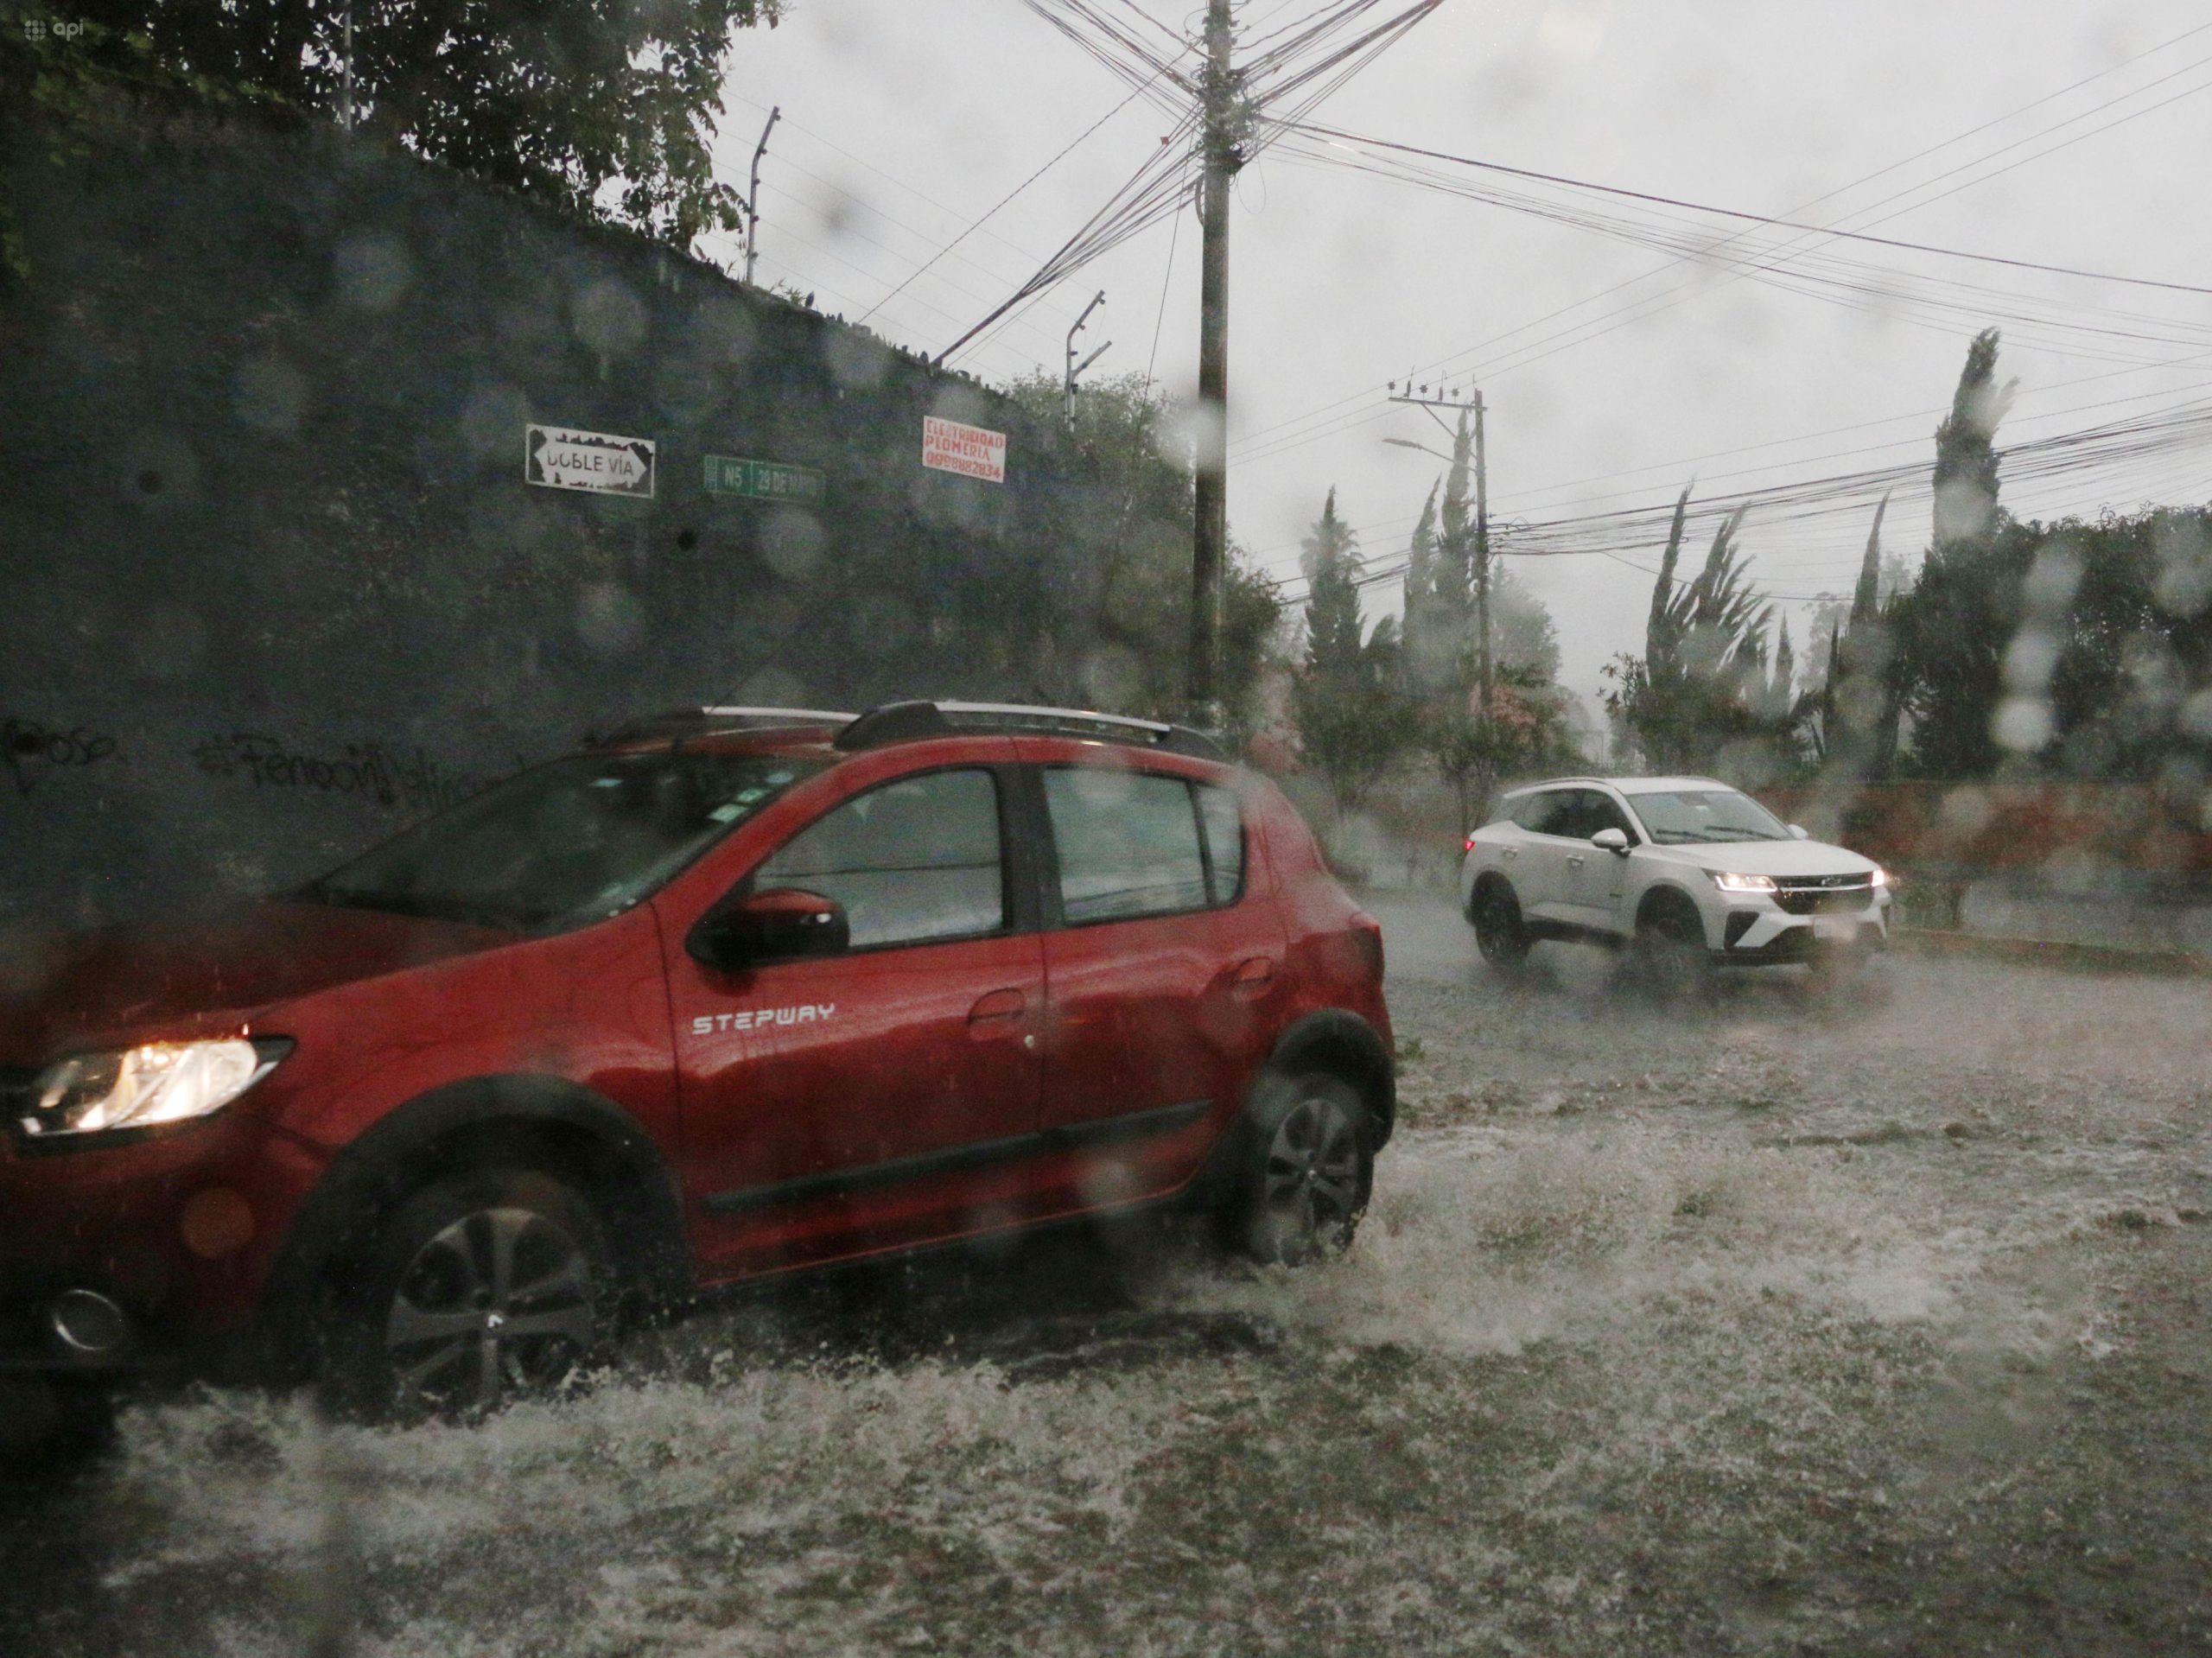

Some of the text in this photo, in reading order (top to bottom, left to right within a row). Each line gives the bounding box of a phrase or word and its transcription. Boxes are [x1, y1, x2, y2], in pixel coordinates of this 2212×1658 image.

[547, 449, 604, 472] DOBLE
[925, 435, 991, 461] PLOMERIA
[691, 1002, 836, 1035] STEPWAY
